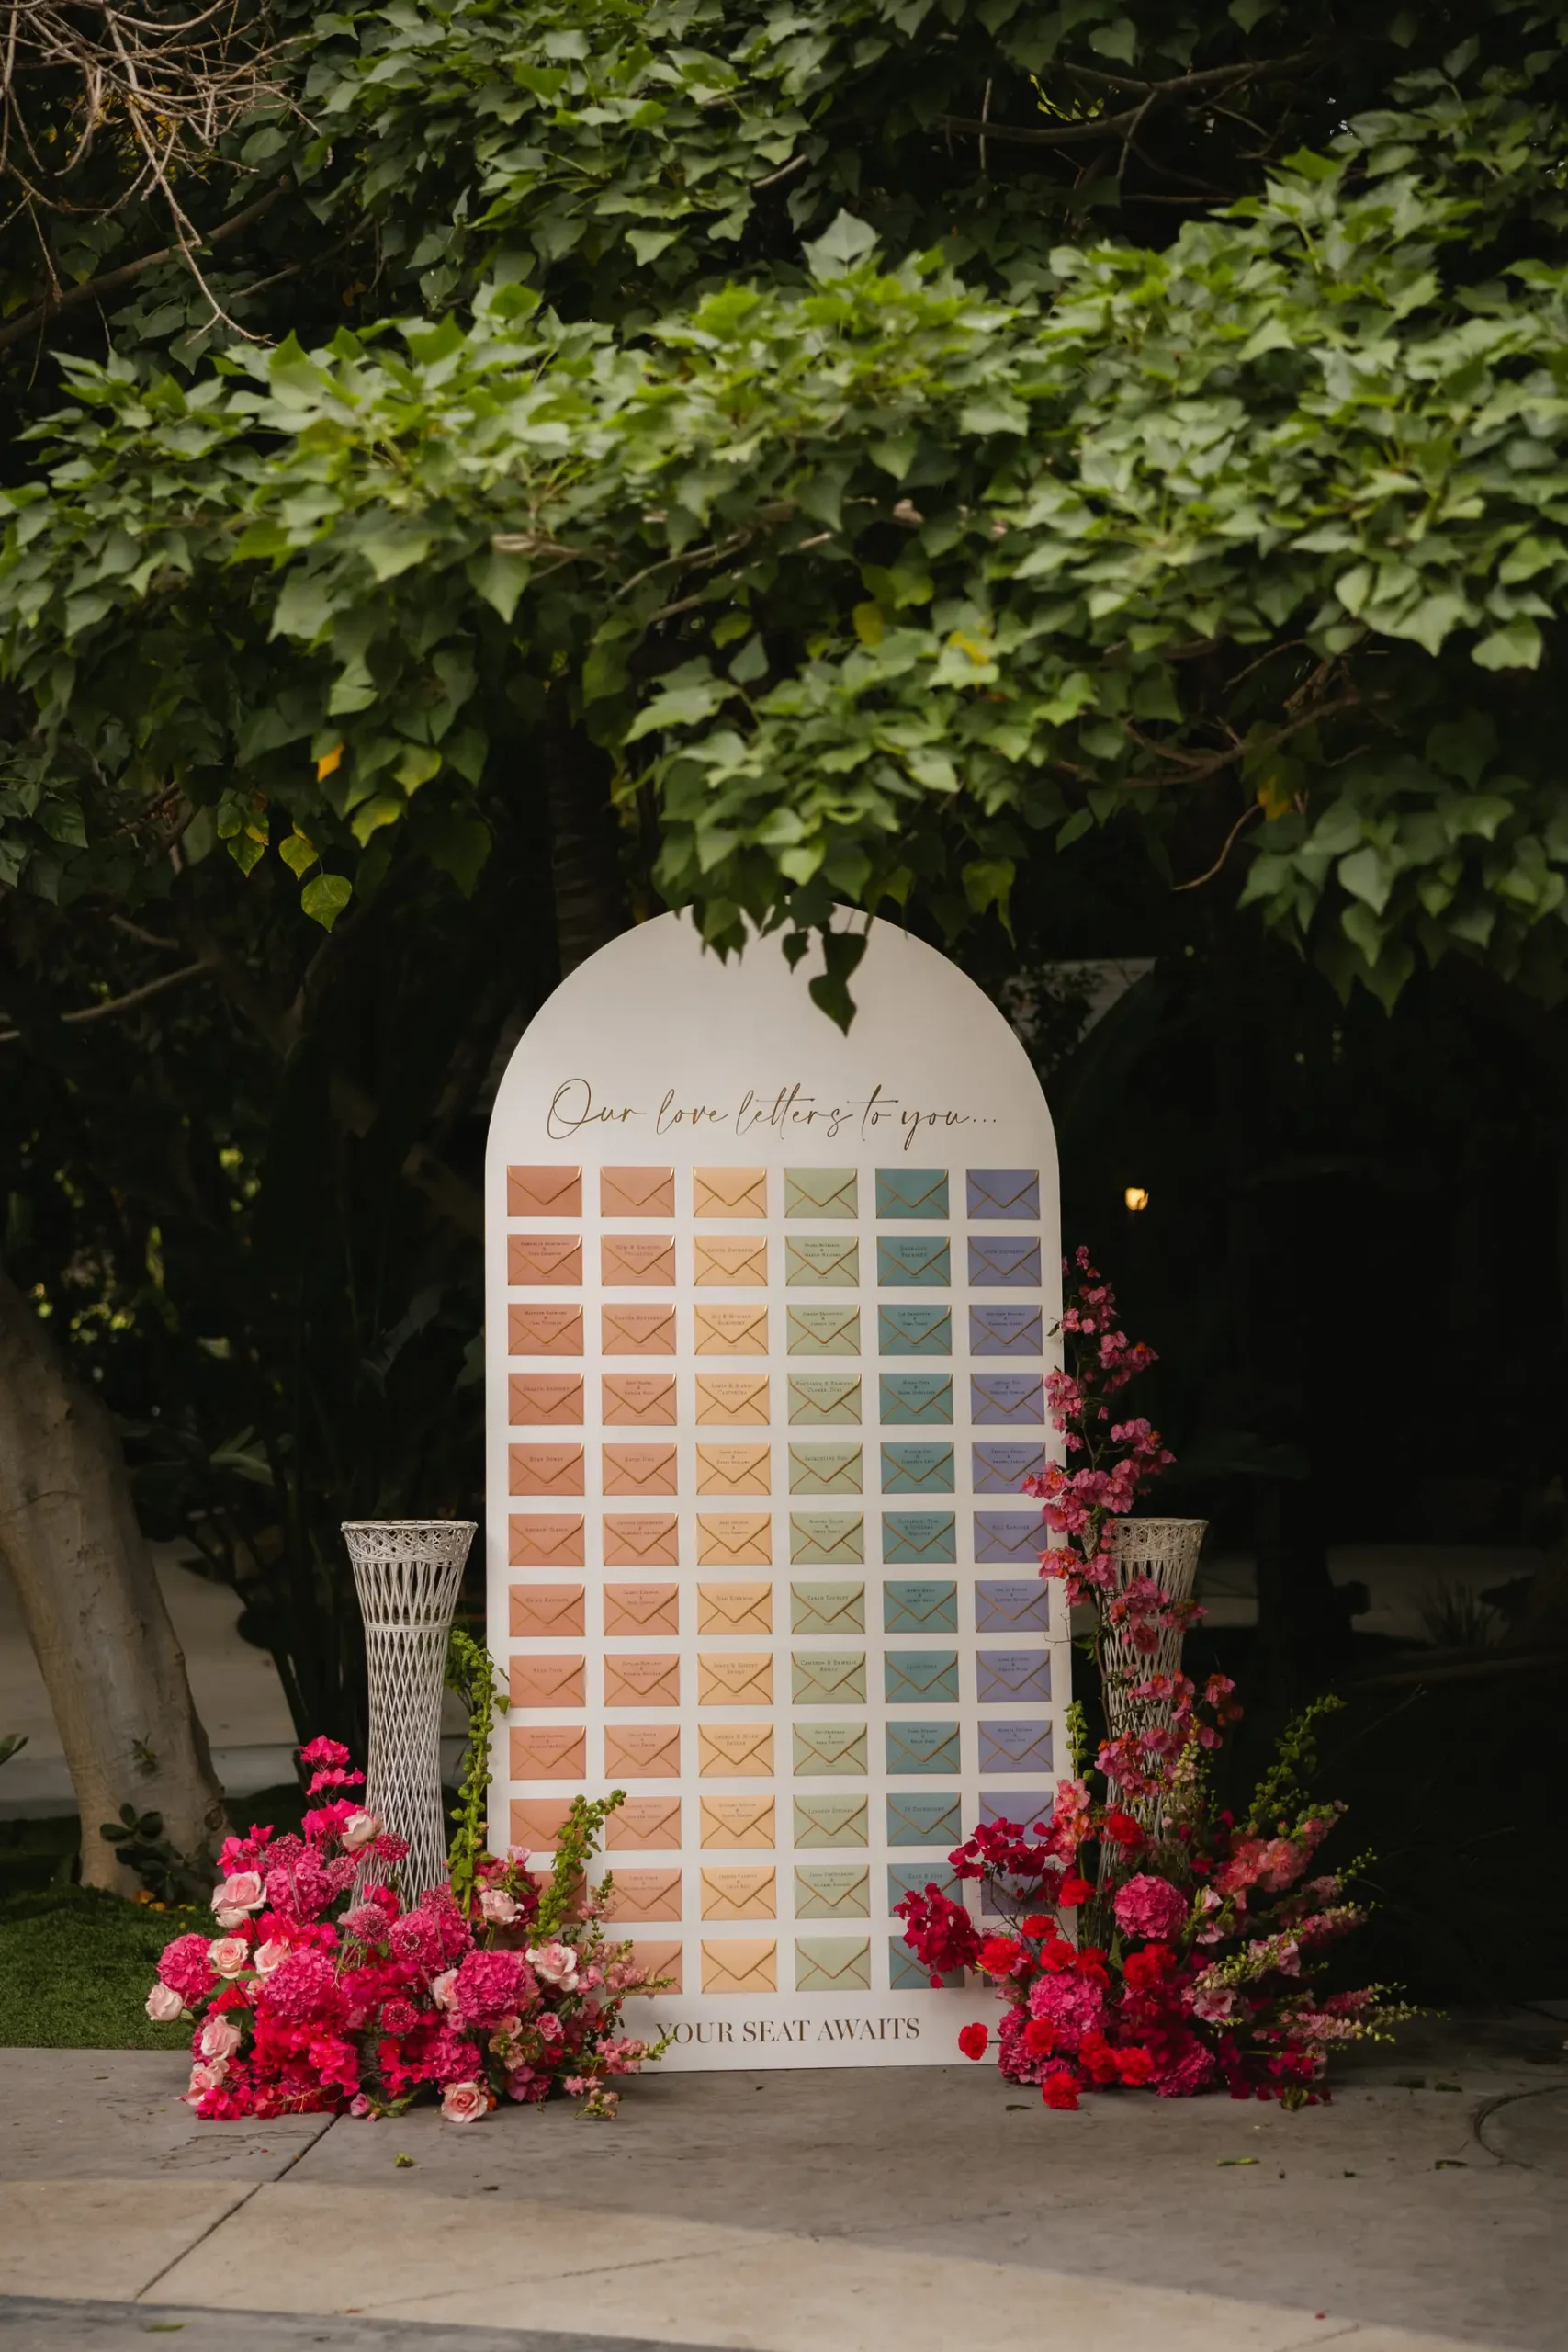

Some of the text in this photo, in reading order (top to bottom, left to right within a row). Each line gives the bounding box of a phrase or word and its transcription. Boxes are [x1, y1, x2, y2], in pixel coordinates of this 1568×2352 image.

[547, 1078, 647, 1140] Our
[656, 1088, 728, 1136] love
[735, 1081, 853, 1139] letters
[847, 1084, 899, 1141] to
[655, 2018, 920, 2044] YOUR SEAT AWAITS
